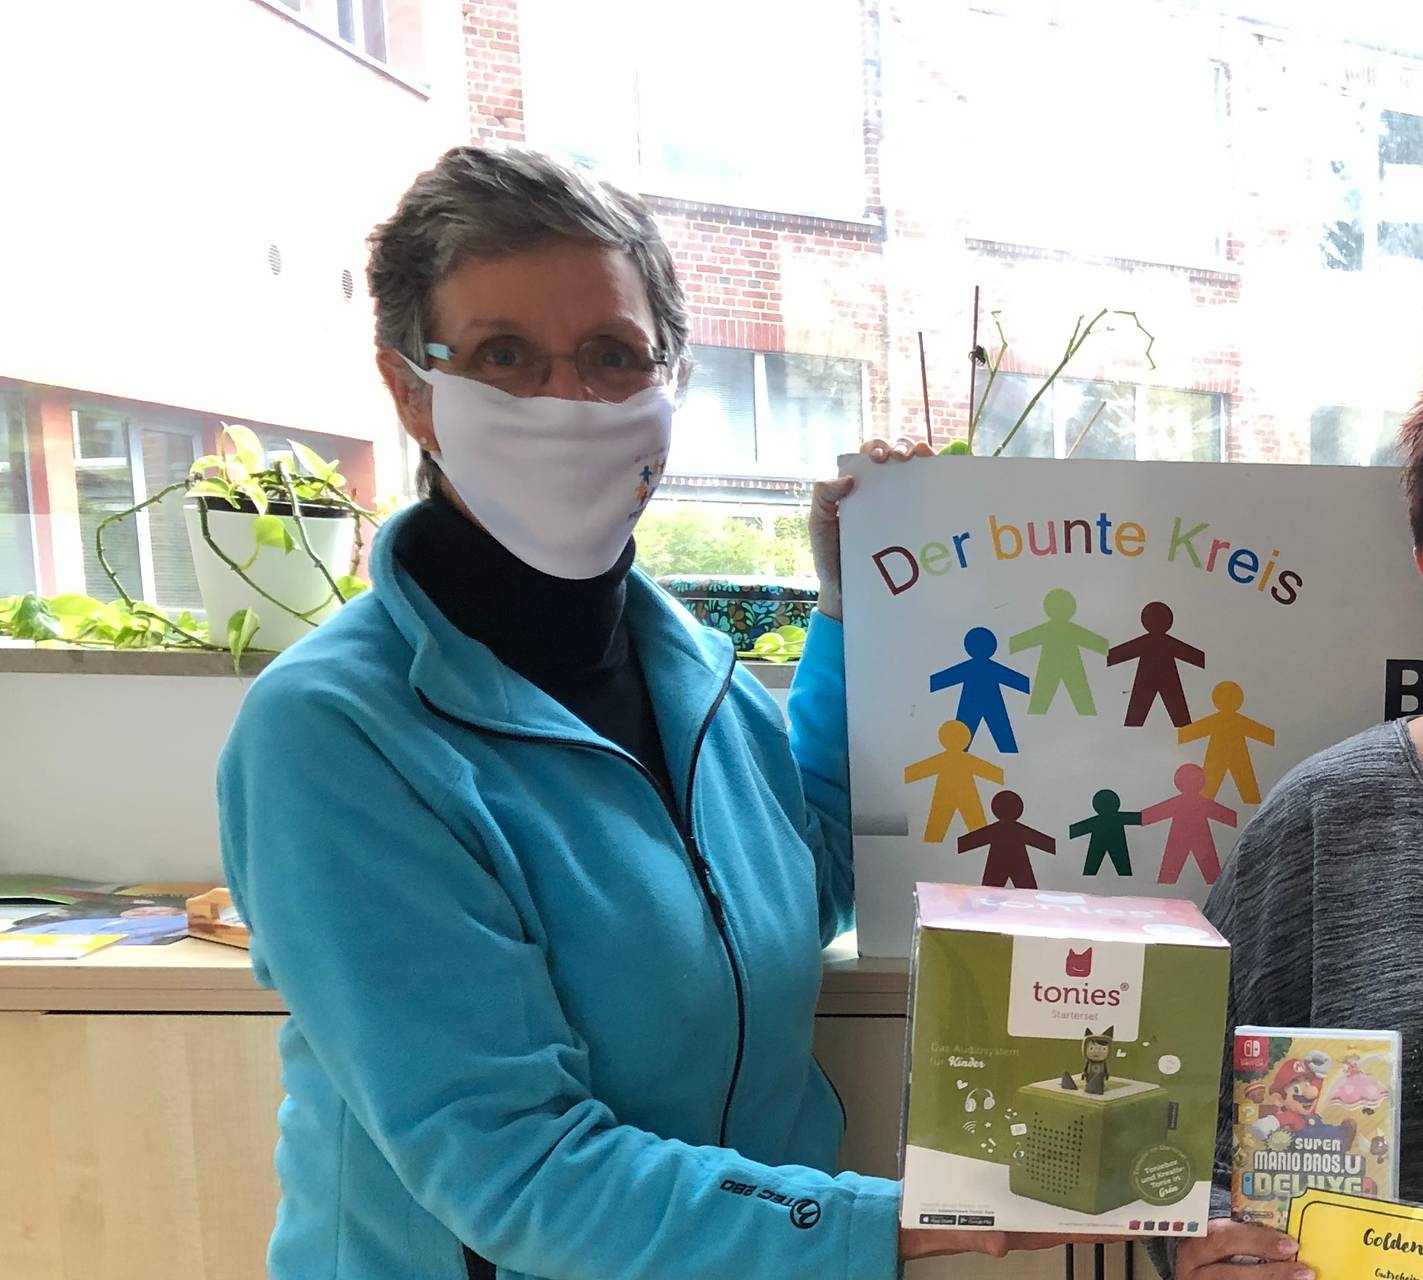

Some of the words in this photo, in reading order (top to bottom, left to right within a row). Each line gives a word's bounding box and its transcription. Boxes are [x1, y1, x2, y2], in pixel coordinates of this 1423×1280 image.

[872, 531, 970, 596] Der
[988, 512, 1146, 562] bunte
[1167, 516, 1304, 606] Kreis
[1051, 1009, 1099, 1021] Starterset
[948, 1055, 985, 1069] Kinder
[1295, 1137, 1341, 1151] SUPER
[1254, 1151, 1300, 1172] MARIO
